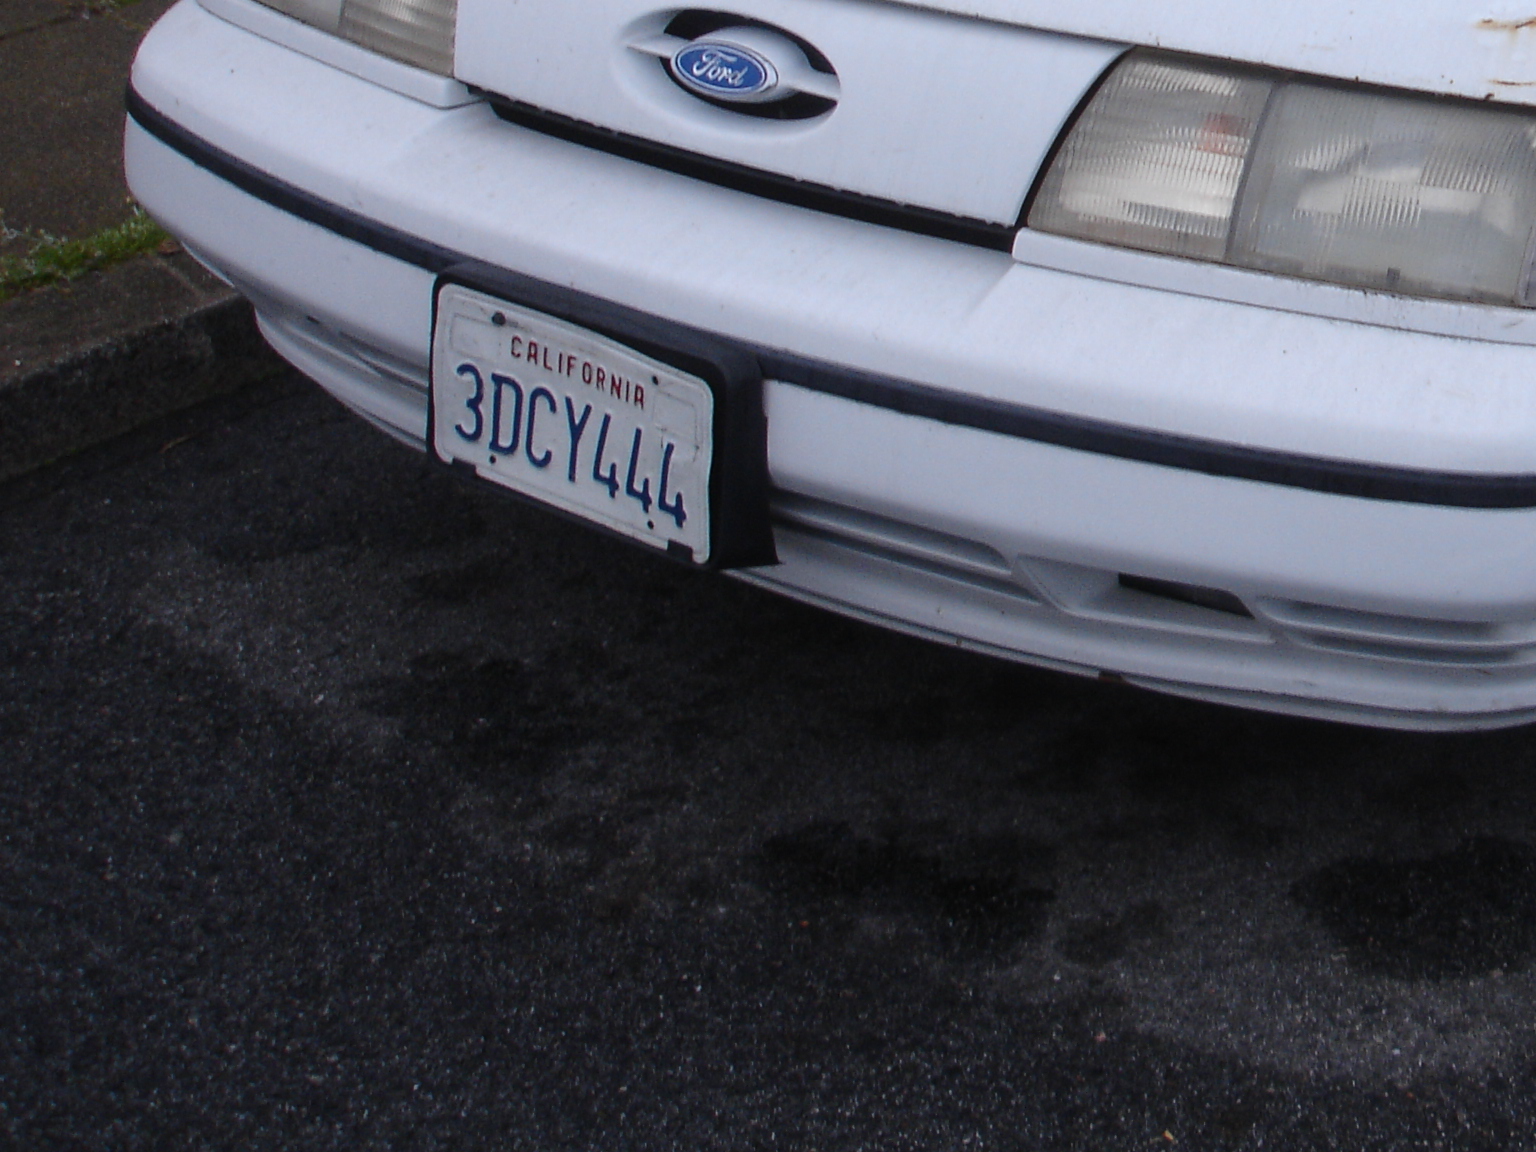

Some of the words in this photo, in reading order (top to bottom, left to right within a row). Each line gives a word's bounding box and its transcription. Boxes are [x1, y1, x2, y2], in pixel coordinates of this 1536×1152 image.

[692, 49, 749, 87] Ford
[510, 335, 646, 410] CALIFORNIA
[454, 362, 688, 530] 3DCY444
